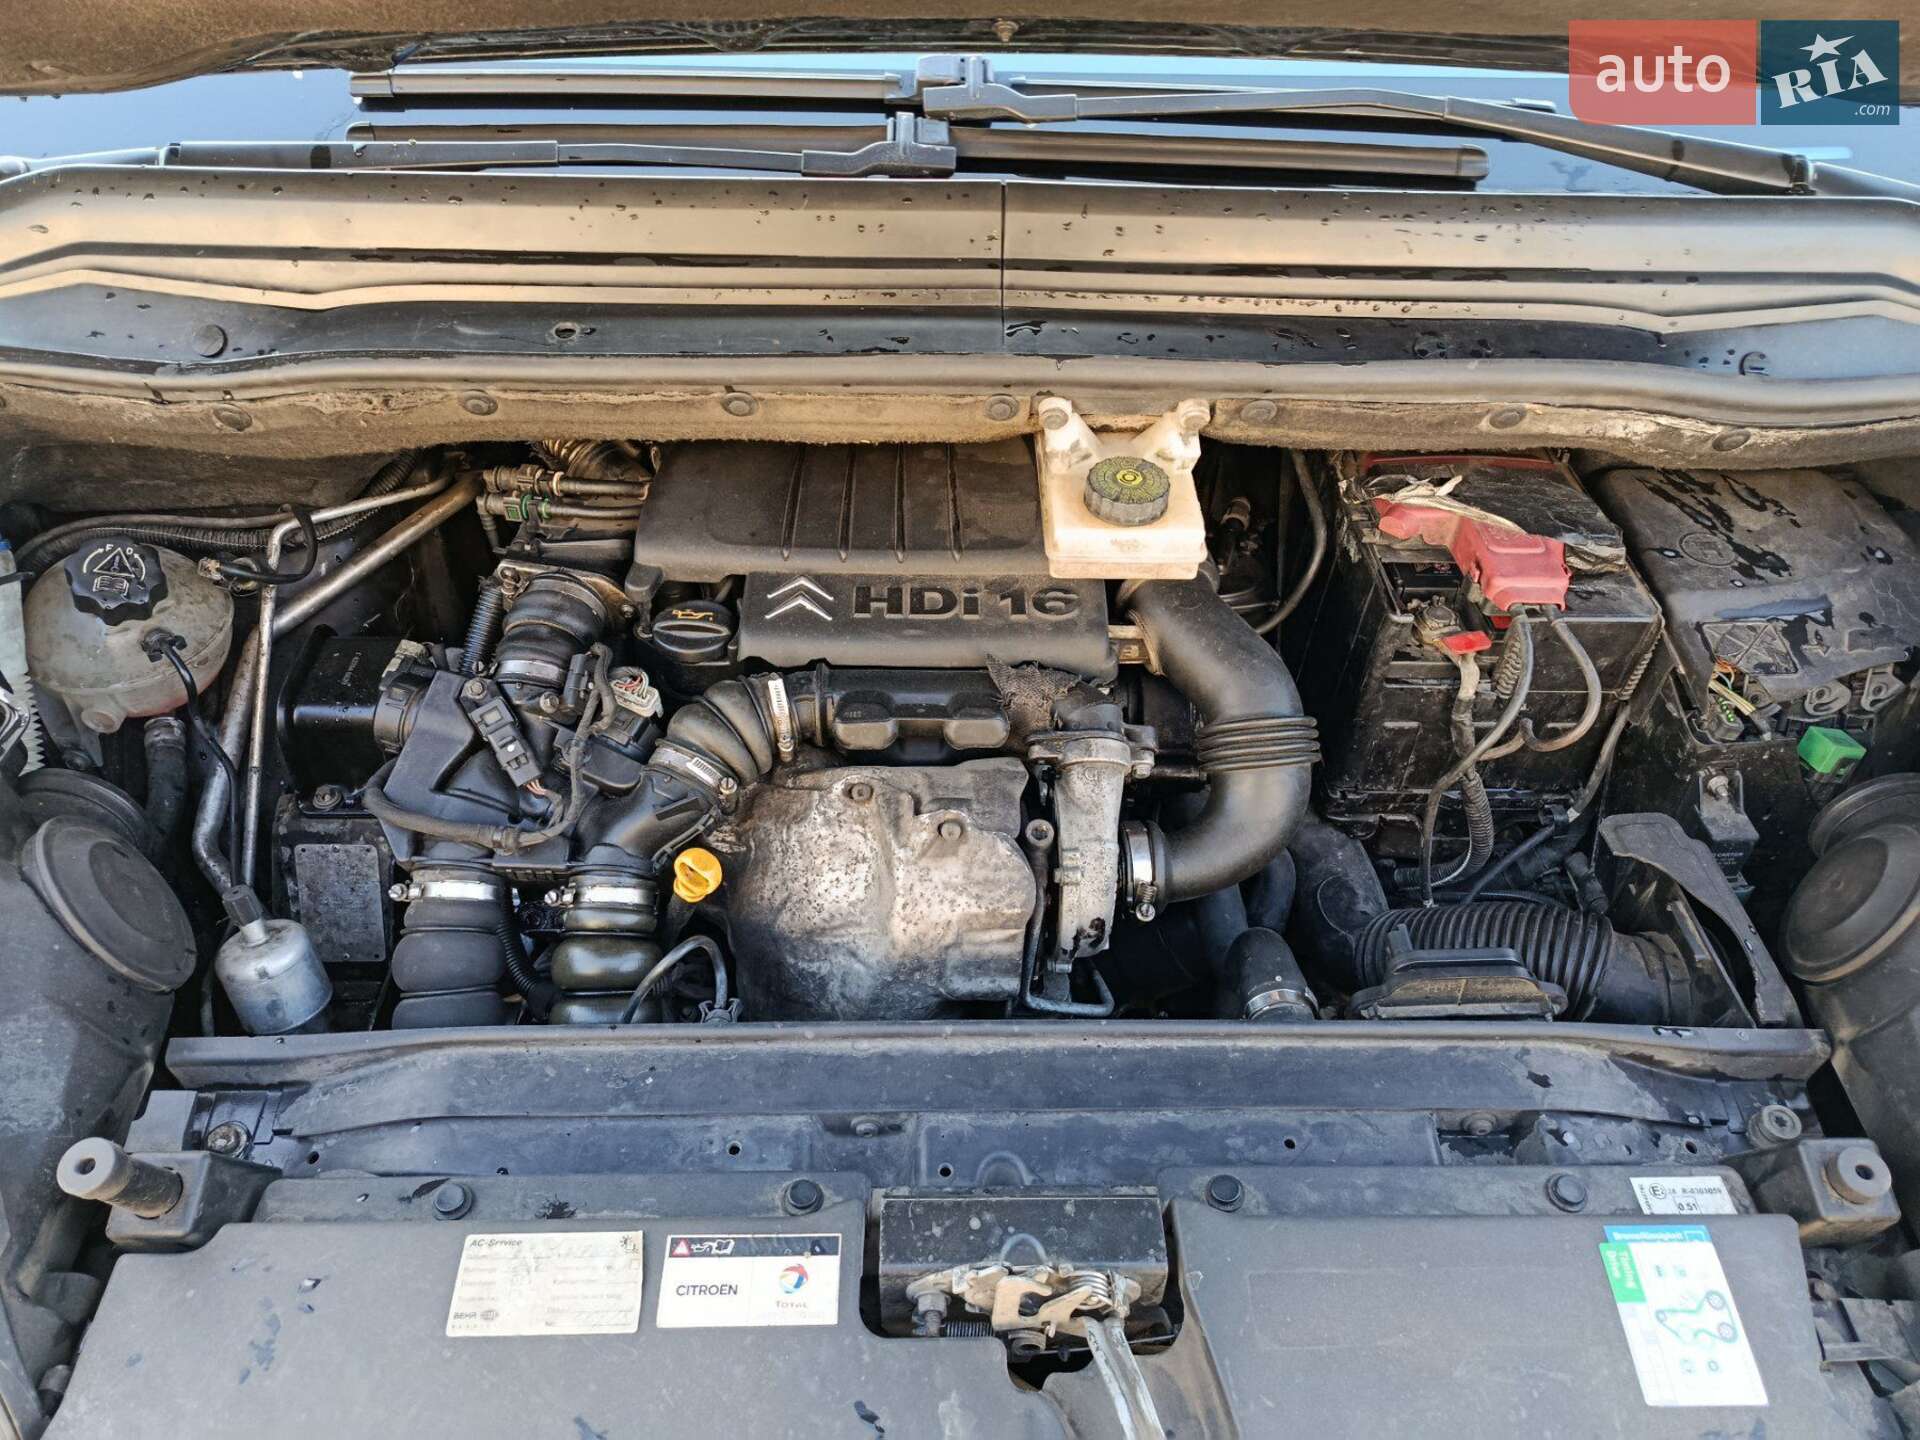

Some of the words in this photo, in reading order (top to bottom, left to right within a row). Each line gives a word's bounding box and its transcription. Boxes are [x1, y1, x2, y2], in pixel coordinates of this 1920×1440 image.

[105, 543, 114, 552] F
[853, 585, 981, 620] HDi
[999, 585, 1080, 621] 16
[676, 1282, 738, 1297] CITROËN
